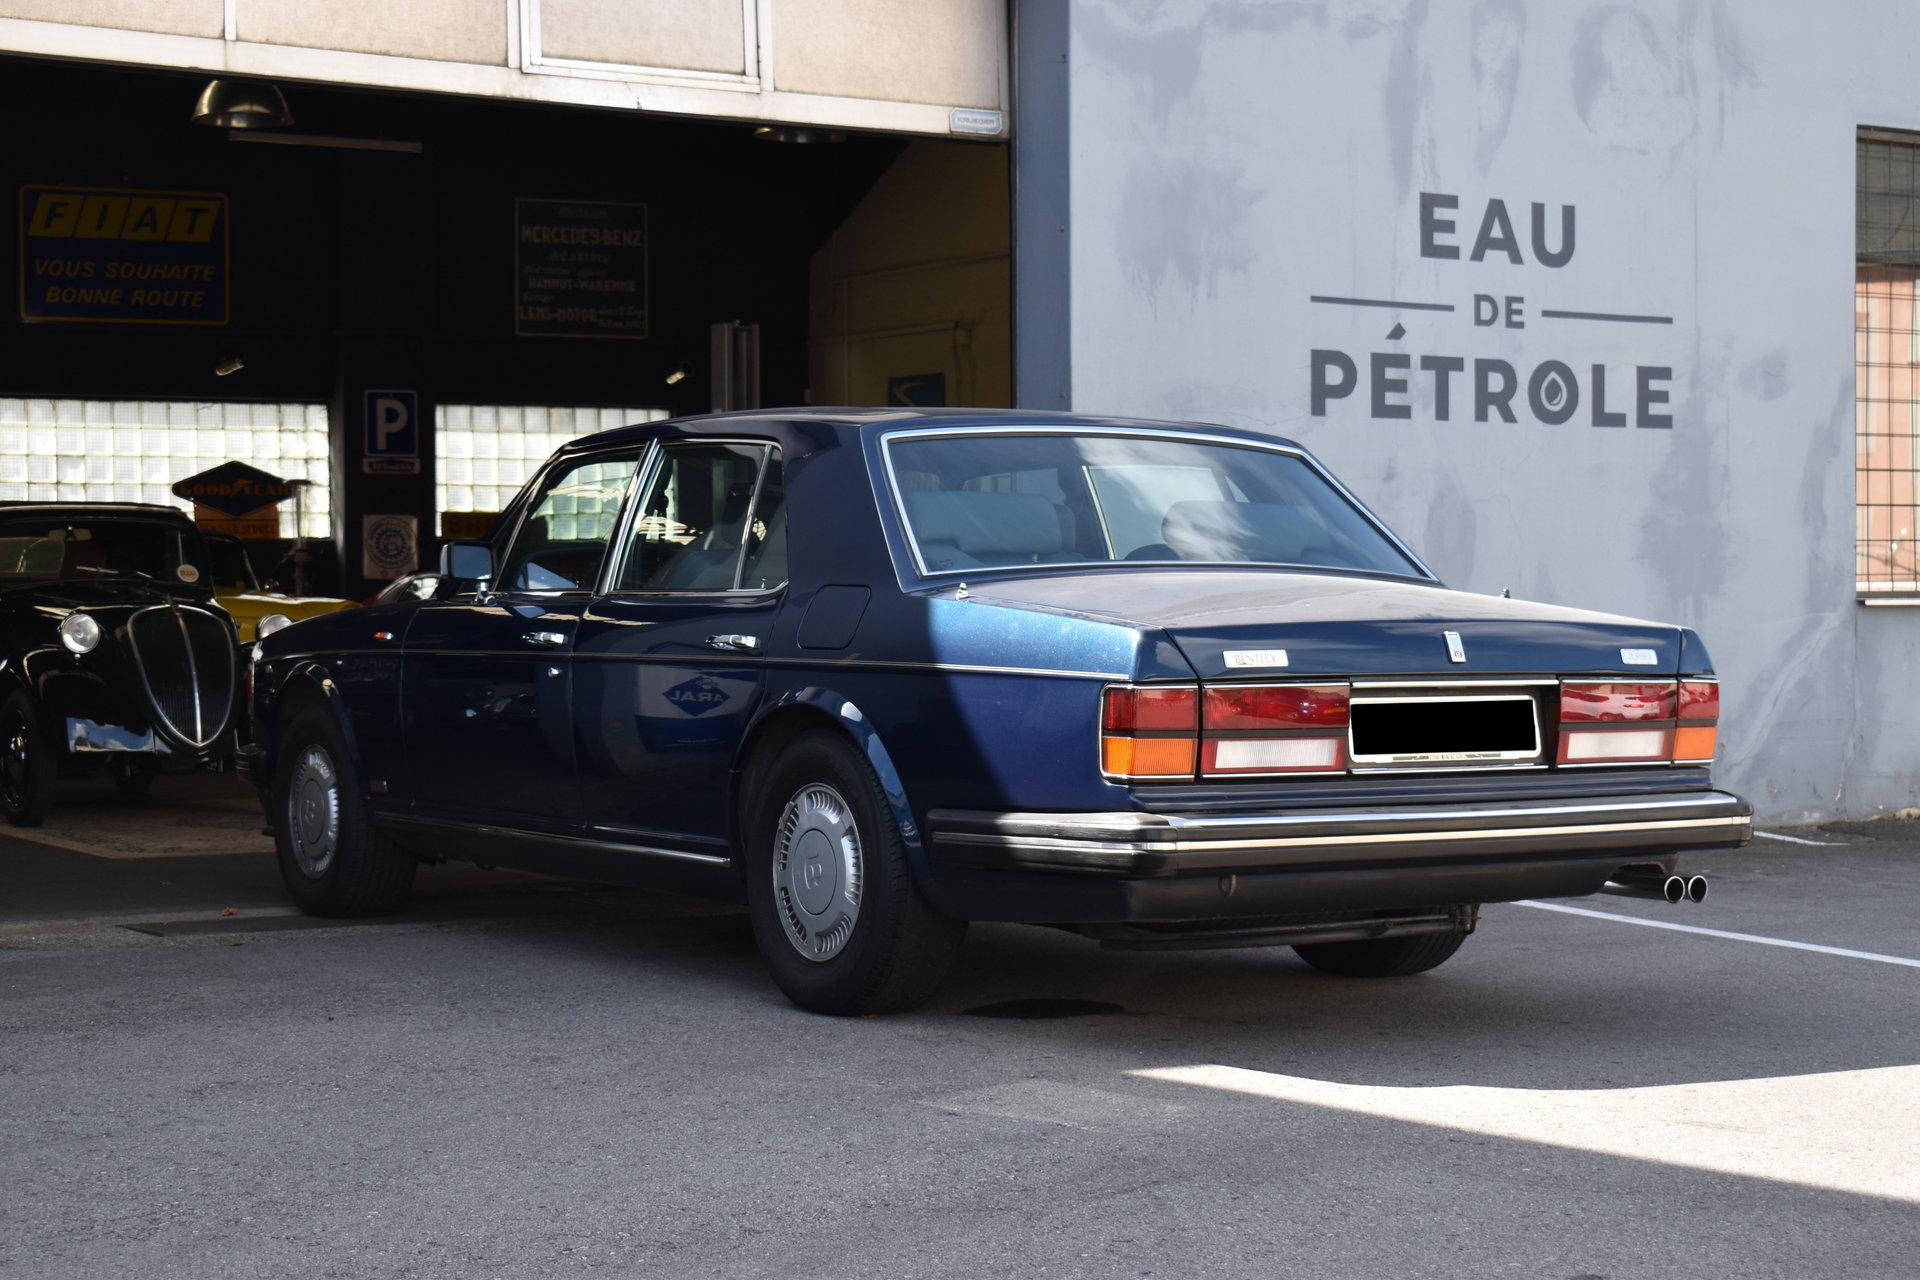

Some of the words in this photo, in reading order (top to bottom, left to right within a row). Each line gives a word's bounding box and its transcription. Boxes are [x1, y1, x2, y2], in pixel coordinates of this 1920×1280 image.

[44, 201, 209, 235] FIAT
[1419, 191, 1576, 269] EAU
[34, 259, 96, 279] VOUS
[104, 262, 216, 281] SOUHAITE
[45, 286, 124, 305] BONNE
[130, 289, 205, 307] ROUTE
[1473, 293, 1526, 330] DE
[1310, 322, 1674, 429] PÉTROLE
[375, 398, 409, 450] P
[178, 482, 290, 497] GOODYEAR
[1234, 653, 1276, 664] BENTLEY
